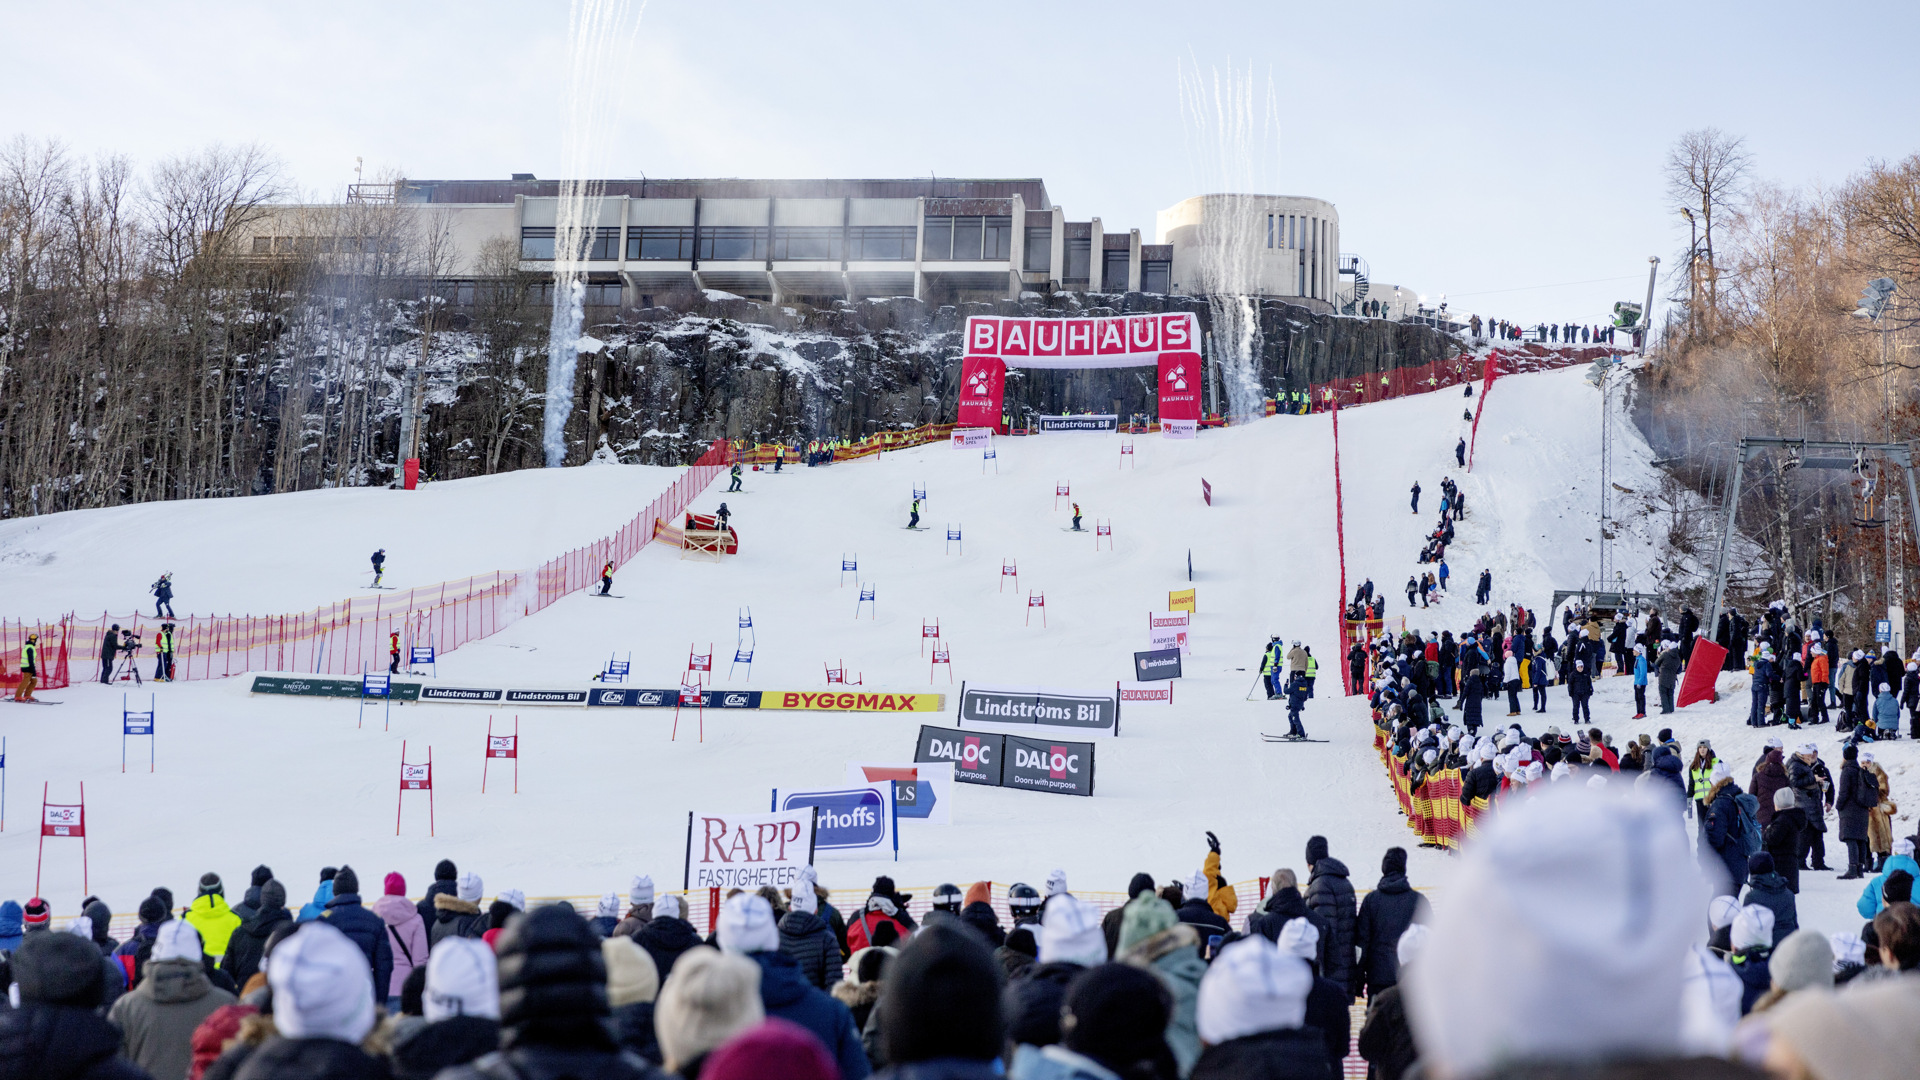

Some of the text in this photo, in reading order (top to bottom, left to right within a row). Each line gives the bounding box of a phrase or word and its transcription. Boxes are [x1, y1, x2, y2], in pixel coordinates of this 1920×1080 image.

[974, 316, 1188, 351] BAUHAUS
[1046, 420, 1110, 430] Lindströms Bil
[428, 689, 496, 699] Lindströms Bil
[512, 691, 580, 701] Lindströms Bil
[600, 691, 623, 704] CEJN
[638, 692, 662, 705] CEJN
[725, 694, 748, 706] CEJN
[783, 693, 915, 711] BYGGMAX
[975, 698, 1100, 722] Lindströms Bil
[929, 738, 991, 764] DALOC
[1015, 748, 1079, 774] DALOC
[1014, 775, 1033, 785] Doors
[1034, 777, 1049, 787] with
[817, 806, 875, 829] rhoffs
[700, 816, 801, 863] RAPP
[698, 866, 797, 887] FASTIGHETER
